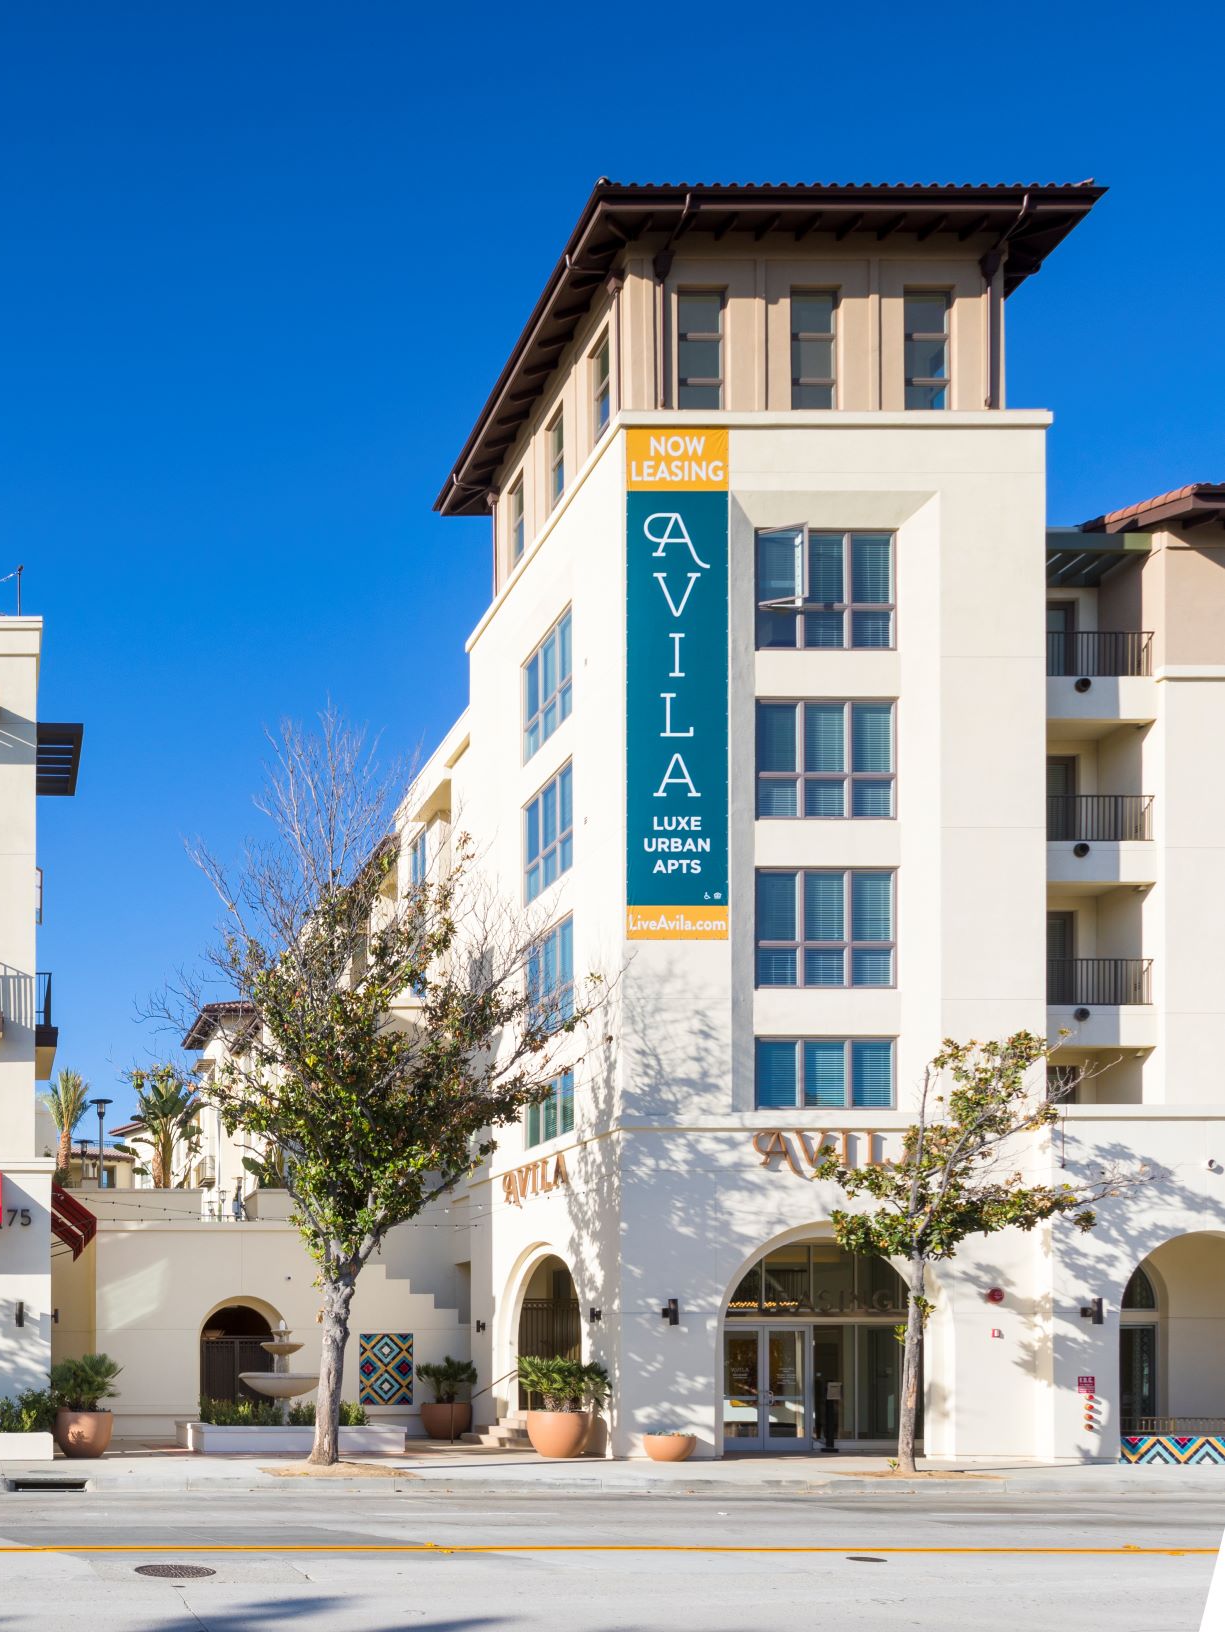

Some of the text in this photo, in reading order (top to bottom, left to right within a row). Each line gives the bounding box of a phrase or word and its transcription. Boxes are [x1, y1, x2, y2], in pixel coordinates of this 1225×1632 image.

[650, 436, 705, 456] NOW
[631, 461, 724, 481] LEASING
[643, 512, 711, 797] AVILA
[653, 816, 702, 831] LUXE
[643, 838, 711, 852] URBAN
[652, 859, 702, 874] APTS
[629, 914, 726, 932] LiveAvila.com
[752, 1129, 918, 1178] AVIL
[503, 1152, 567, 1207] AVILA
[7, 1209, 32, 1227] 75
